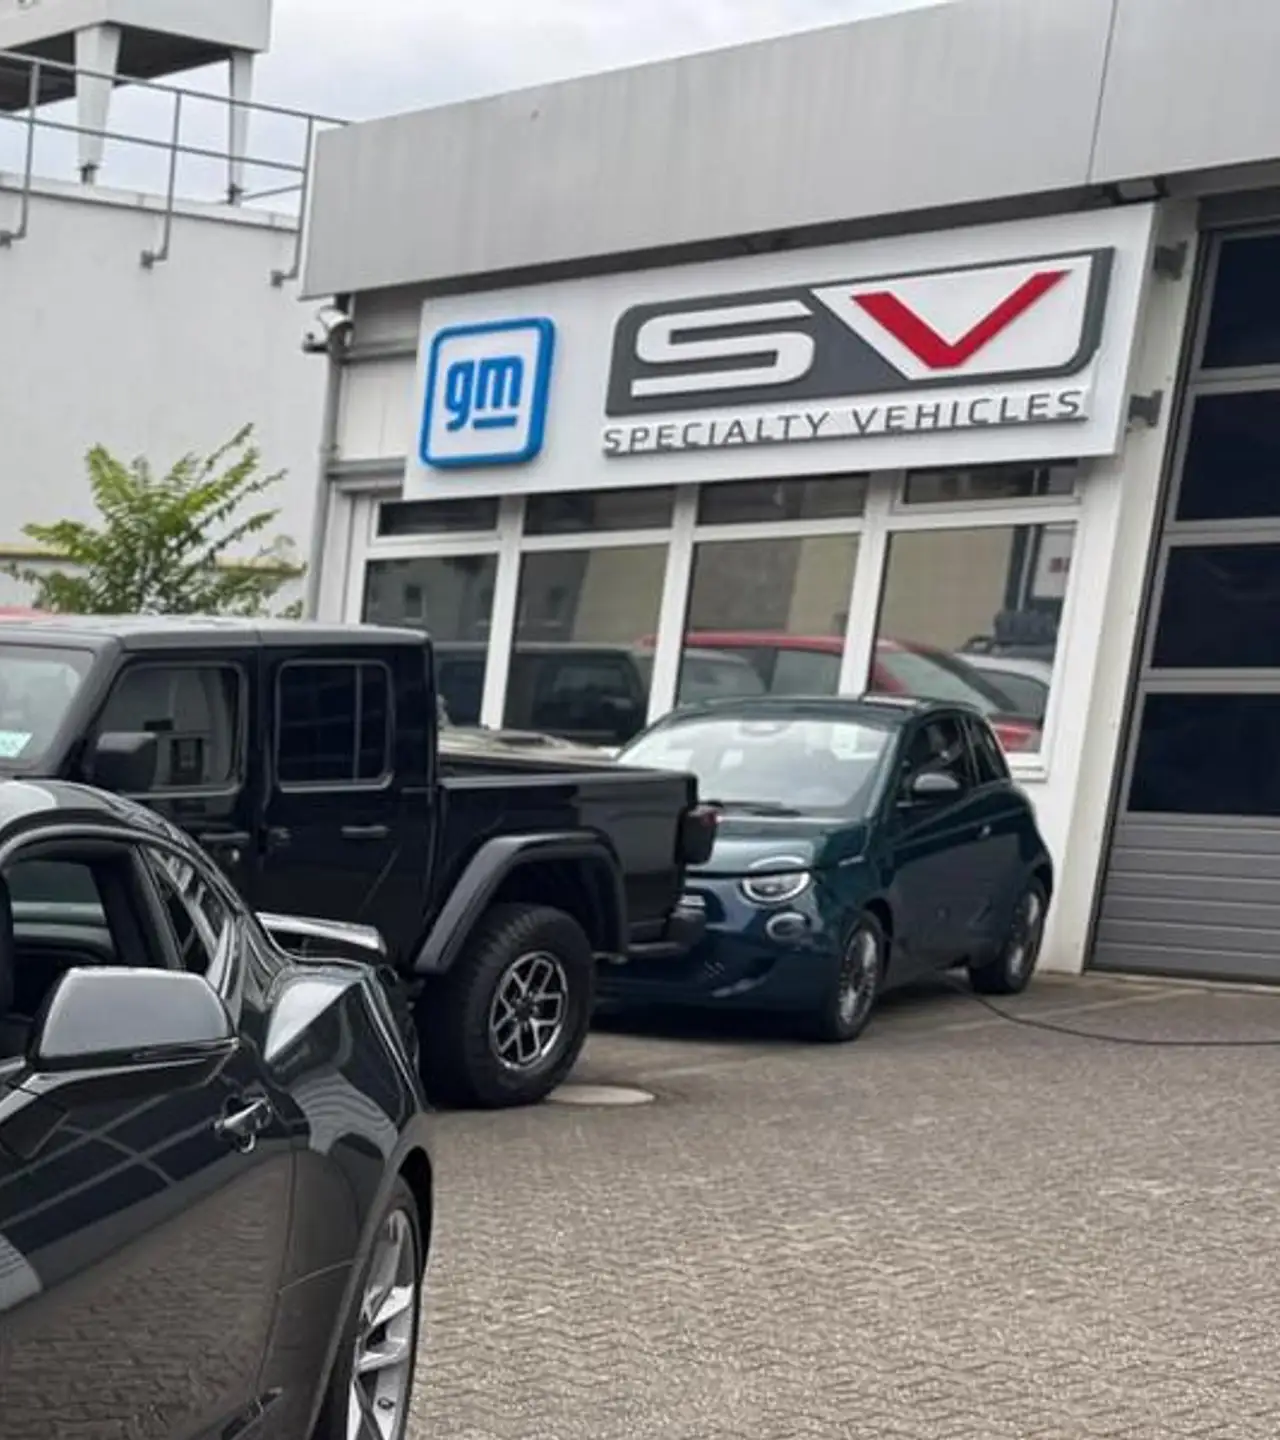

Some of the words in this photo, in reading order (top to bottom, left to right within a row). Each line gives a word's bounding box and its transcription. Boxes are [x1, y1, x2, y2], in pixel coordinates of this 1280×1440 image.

[630, 268, 1074, 398] SV
[444, 355, 525, 433] gm
[603, 410, 831, 453] SPECIALTY
[852, 389, 1084, 436] VEHICLES
